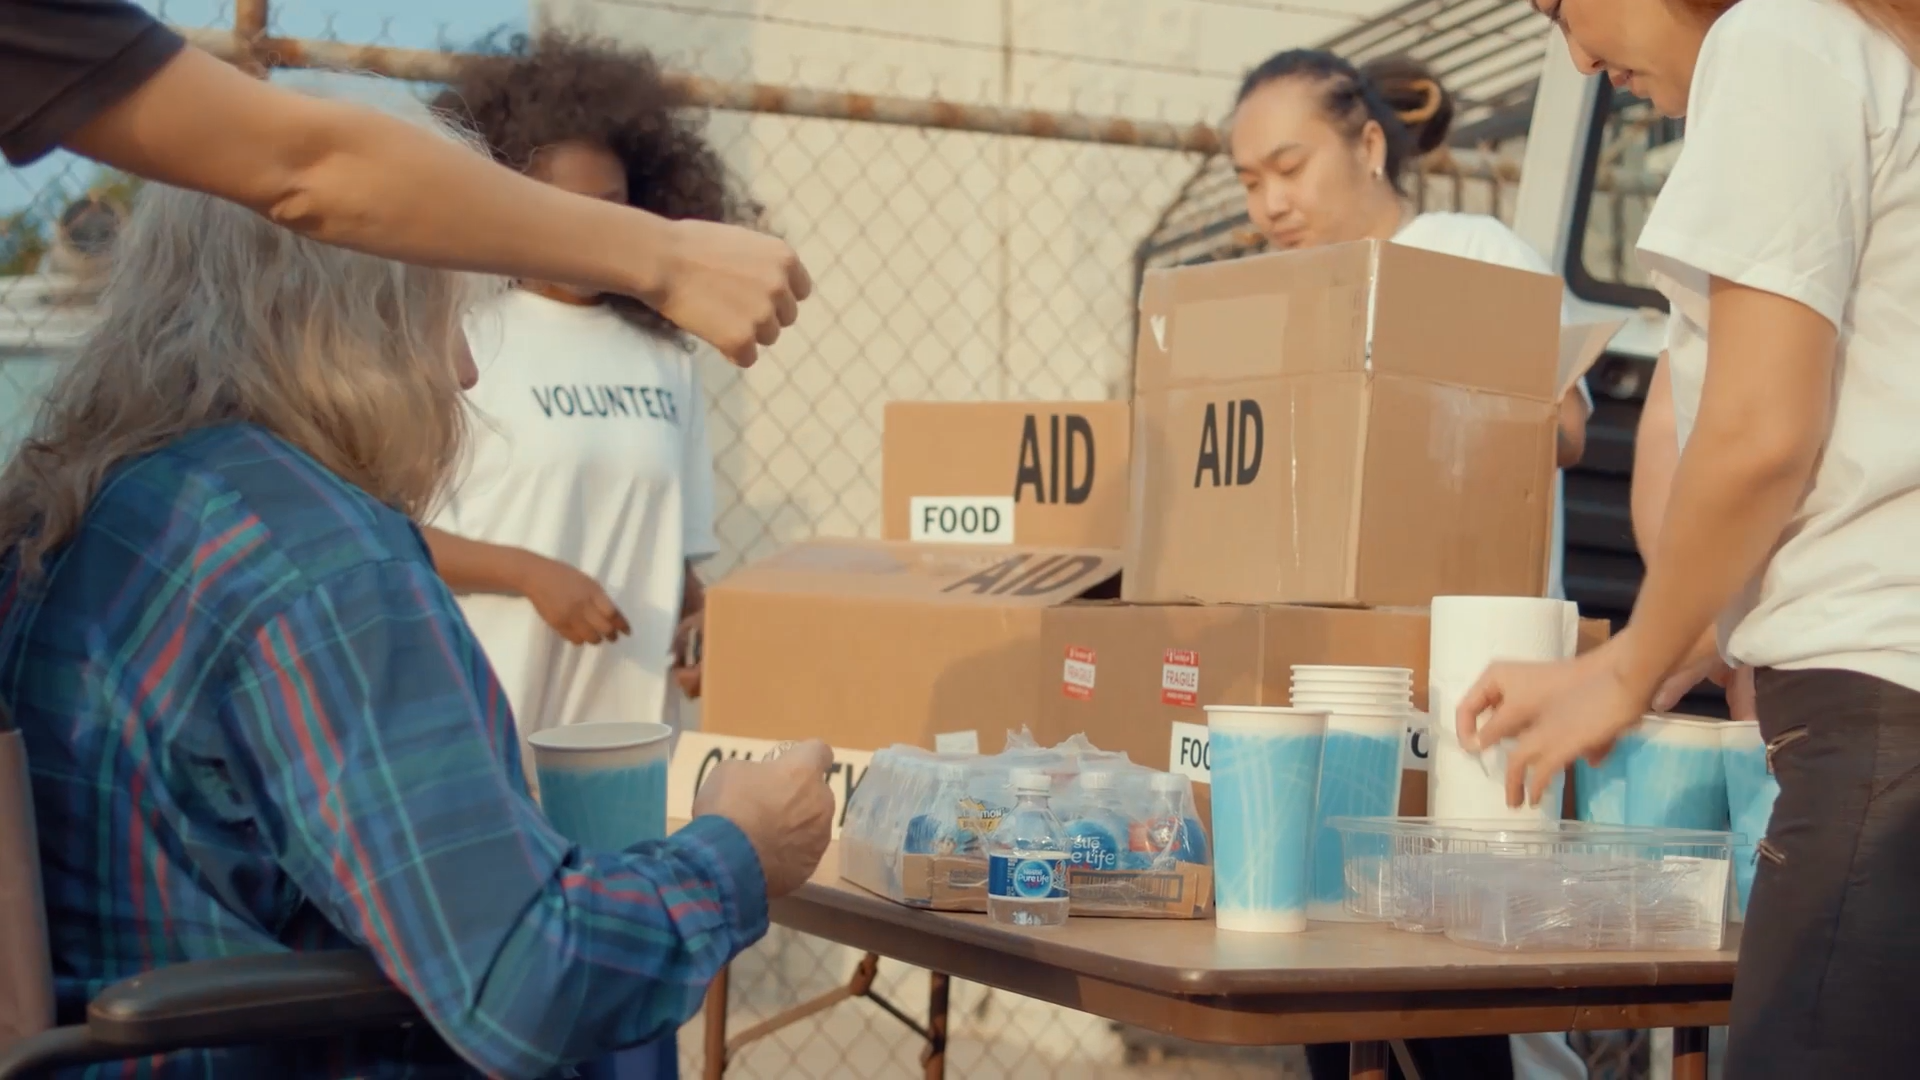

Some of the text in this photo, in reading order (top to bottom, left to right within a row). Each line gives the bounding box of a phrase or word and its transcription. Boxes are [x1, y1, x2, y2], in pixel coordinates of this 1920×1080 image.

[1014, 413, 1096, 505] AID
[1194, 399, 1264, 489] AID
[923, 505, 1001, 534] FOOD
[942, 553, 1103, 597] AID
[1165, 669, 1196, 688] FRAGILE
